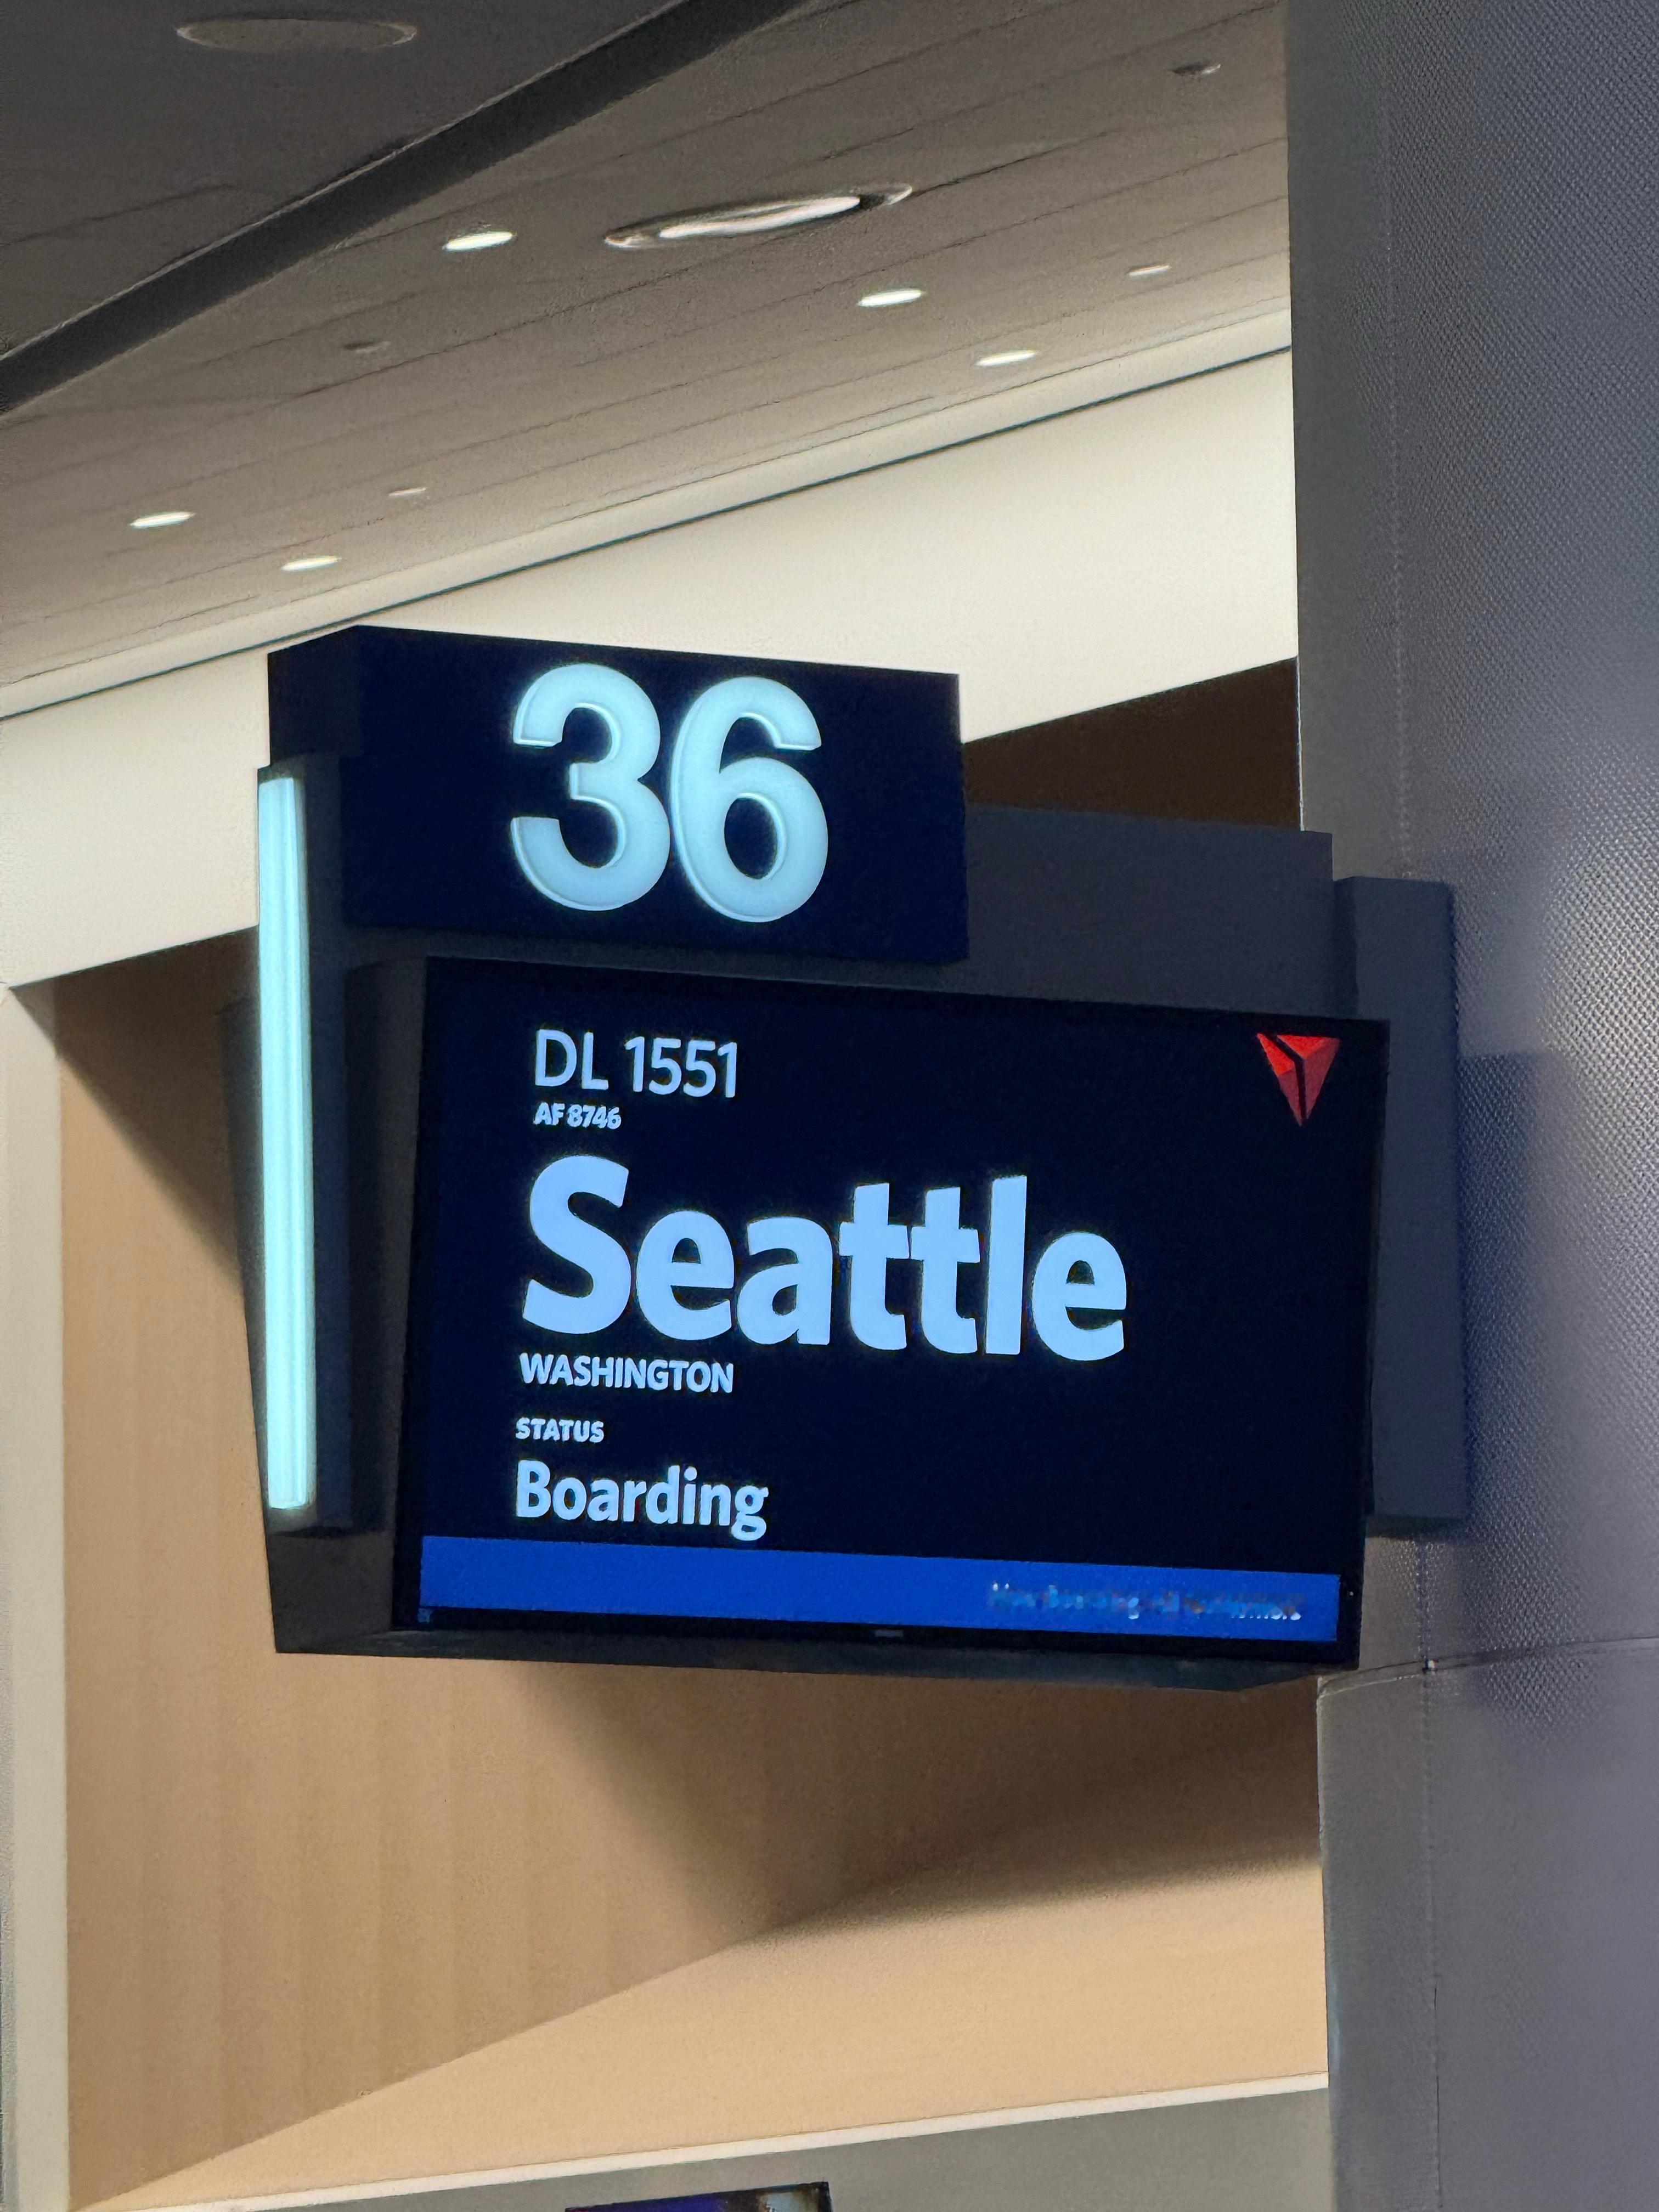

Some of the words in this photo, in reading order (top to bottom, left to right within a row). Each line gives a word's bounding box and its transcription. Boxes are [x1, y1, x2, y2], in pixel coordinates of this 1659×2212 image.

[509, 662, 829, 923] 36
[534, 1028, 610, 1091] DL
[624, 1035, 738, 1098] 1551
[532, 1101, 566, 1126] AF
[566, 1103, 622, 1130] 8746
[522, 1153, 1127, 1362] Seattle
[518, 1352, 735, 1394] WASHINGTON
[515, 1417, 605, 1444] STATUS
[515, 1459, 770, 1542] Boarding
